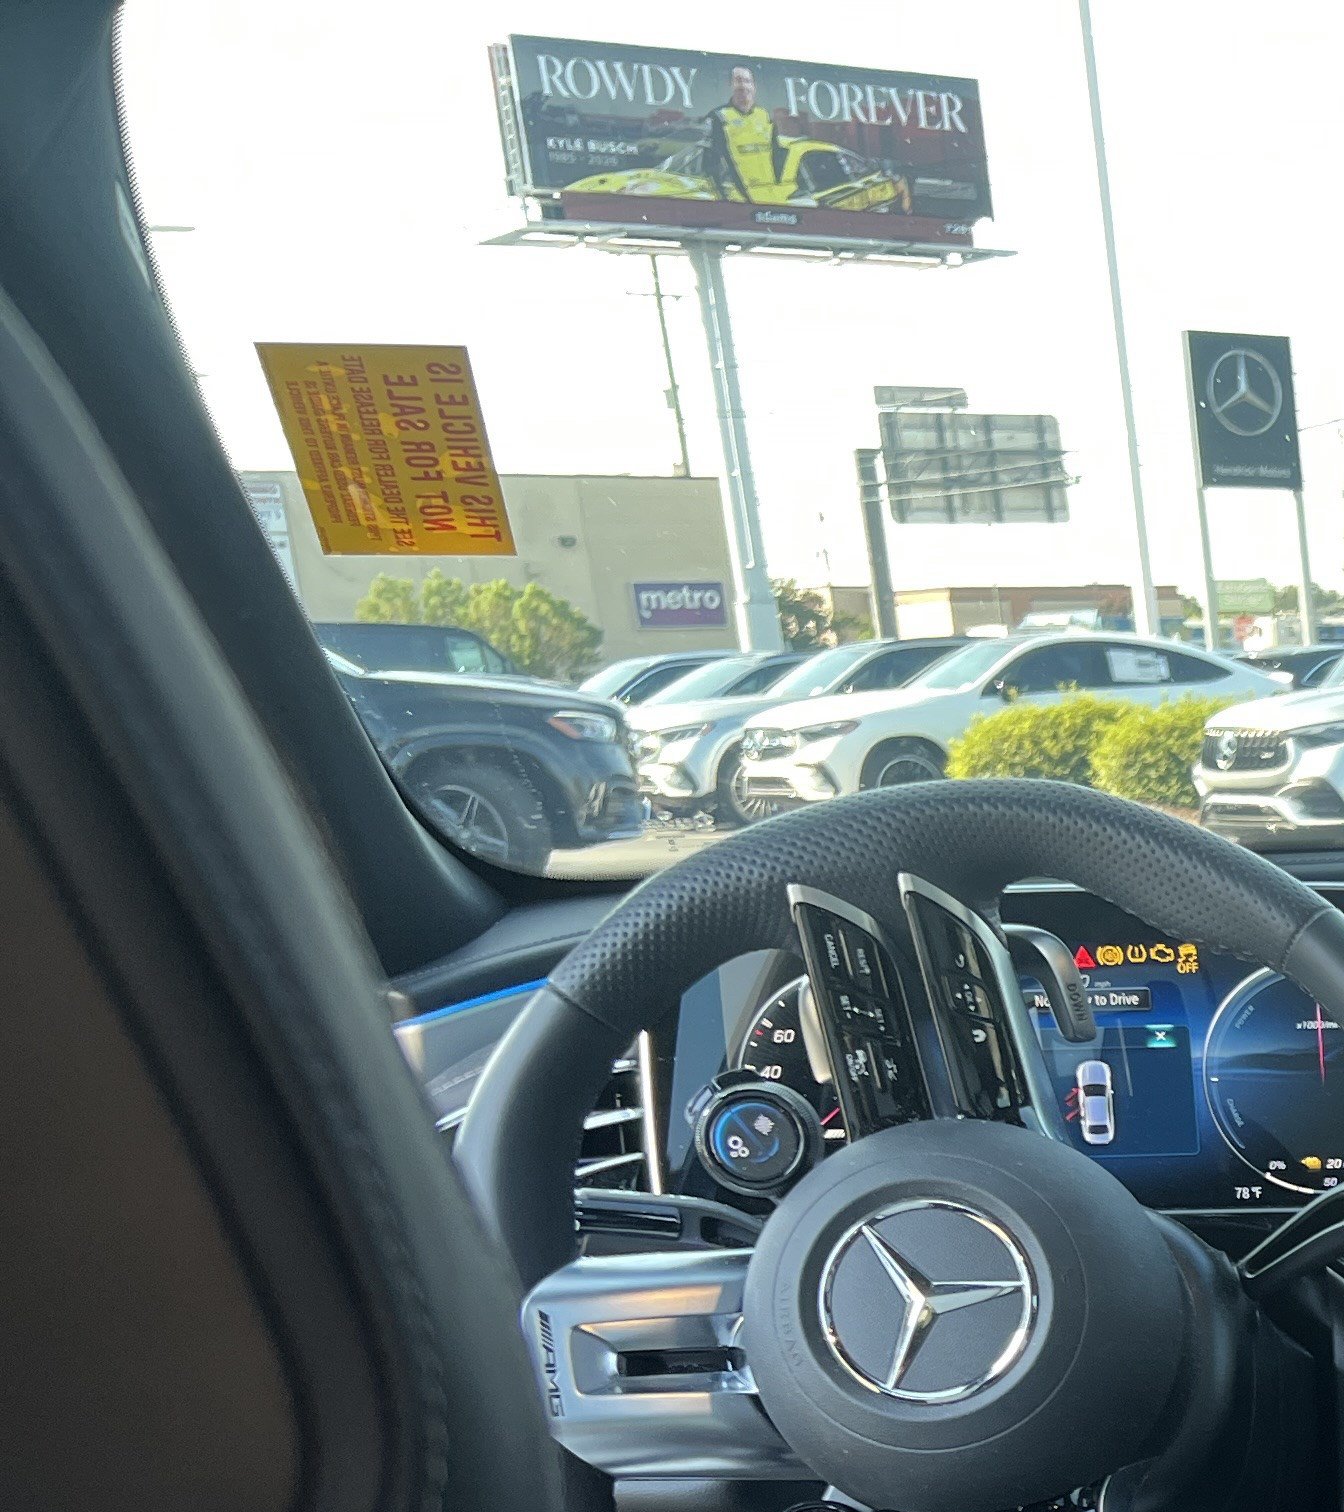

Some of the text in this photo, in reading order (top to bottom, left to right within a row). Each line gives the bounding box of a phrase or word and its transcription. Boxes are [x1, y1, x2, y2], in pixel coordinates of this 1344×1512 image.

[536, 54, 968, 133] ROWDY FOREVER
[640, 585, 720, 619] metro
[825, 934, 840, 969] CANCEL
[1177, 962, 1199, 974] OFF
[1066, 983, 1088, 1022] DOWN
[1095, 995, 1107, 1006] to
[1110, 992, 1140, 1006] Drive
[773, 1029, 796, 1044] 60
[760, 1065, 783, 1080] 40
[1269, 1160, 1287, 1170] 0%
[1325, 1159, 1342, 1169] 20
[1235, 1187, 1251, 1199] 78
